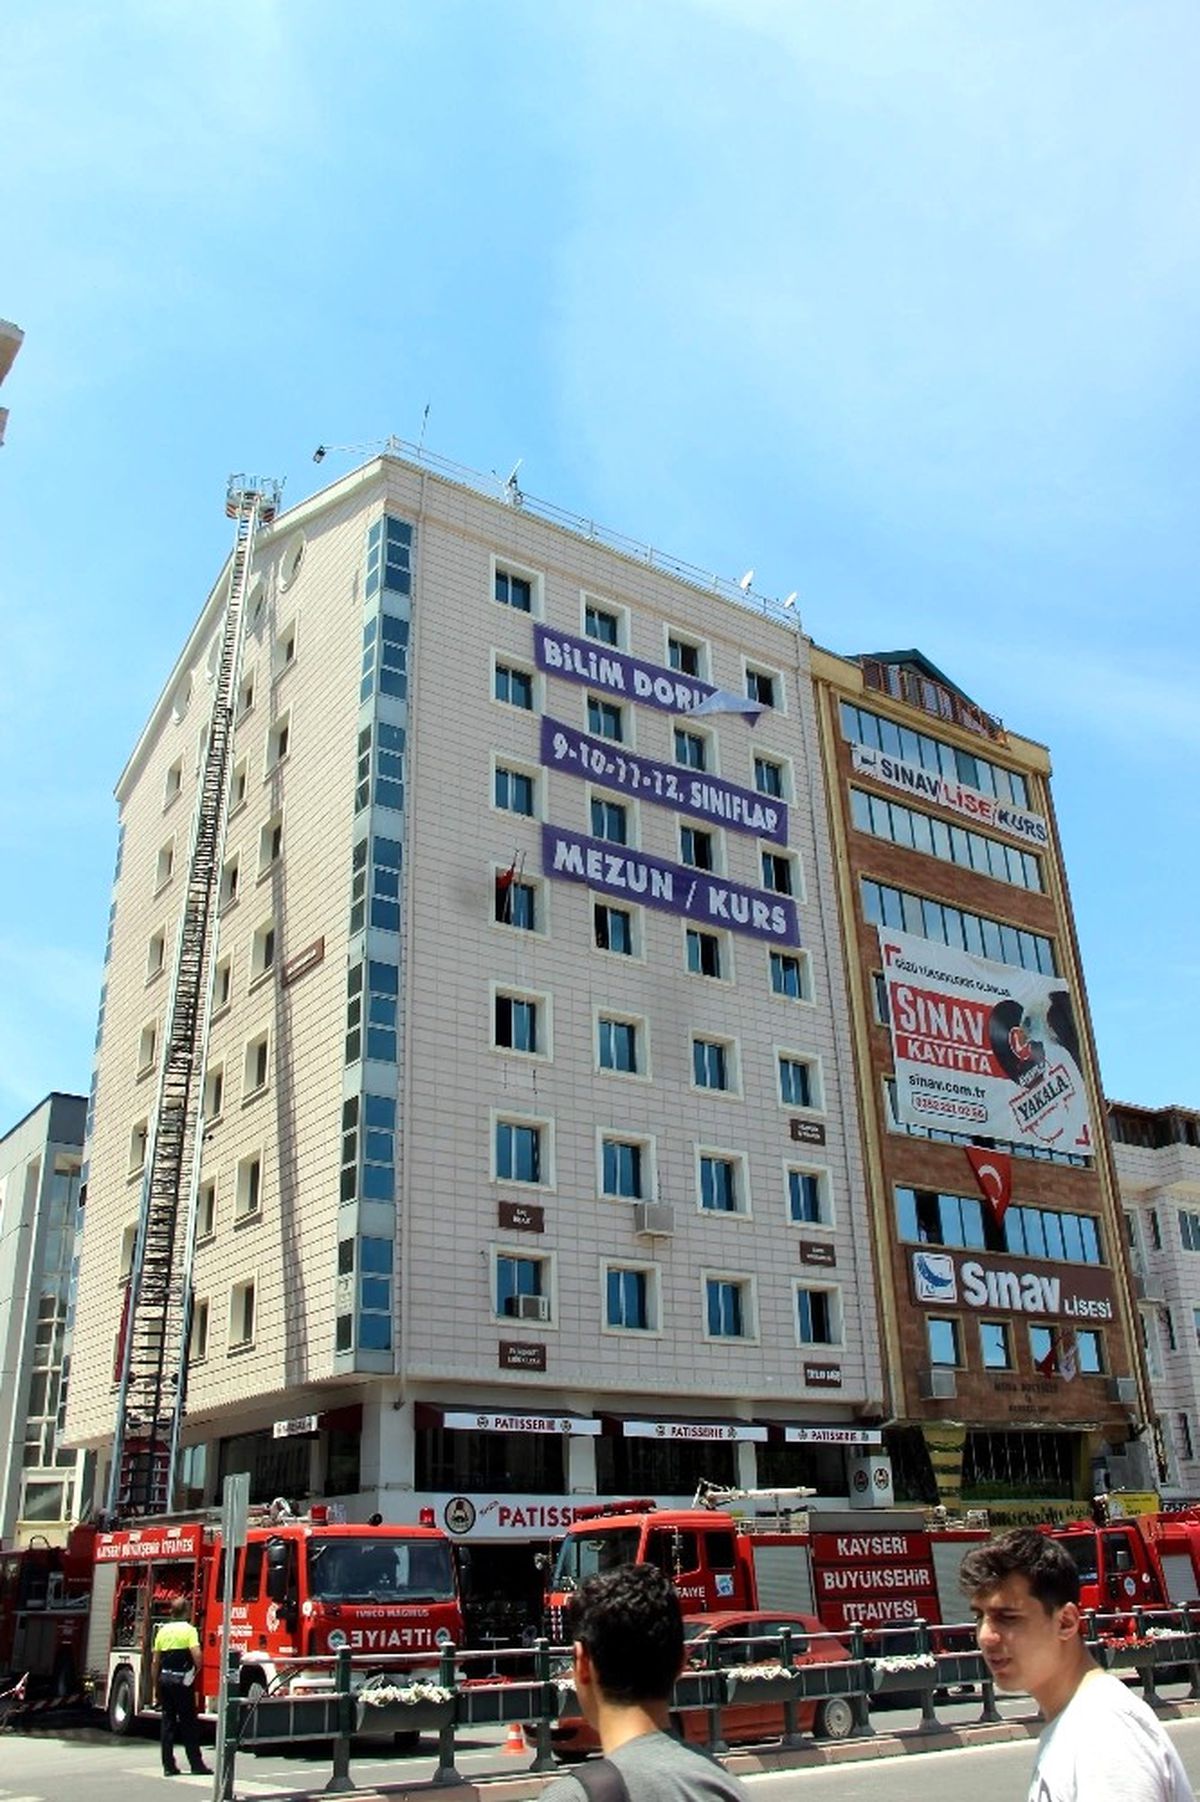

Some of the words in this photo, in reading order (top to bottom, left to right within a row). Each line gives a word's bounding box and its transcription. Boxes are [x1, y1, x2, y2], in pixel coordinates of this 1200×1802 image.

[881, 758, 941, 797] SINAV
[690, 781, 778, 834] SINIFLAR
[553, 840, 673, 901] MEZUN
[708, 886, 787, 934] KURS
[896, 986, 984, 1046] SINAV
[907, 1040, 992, 1074] KAYITTA
[909, 1073, 985, 1098] sinav.com.tr
[1018, 1075, 1068, 1121] YAKALA
[495, 1417, 555, 1430] PATISSERIE
[671, 1426, 723, 1438] PATISSERIE
[811, 1431, 856, 1441] PATISSERIE
[837, 1537, 908, 1556] KAYSERİ
